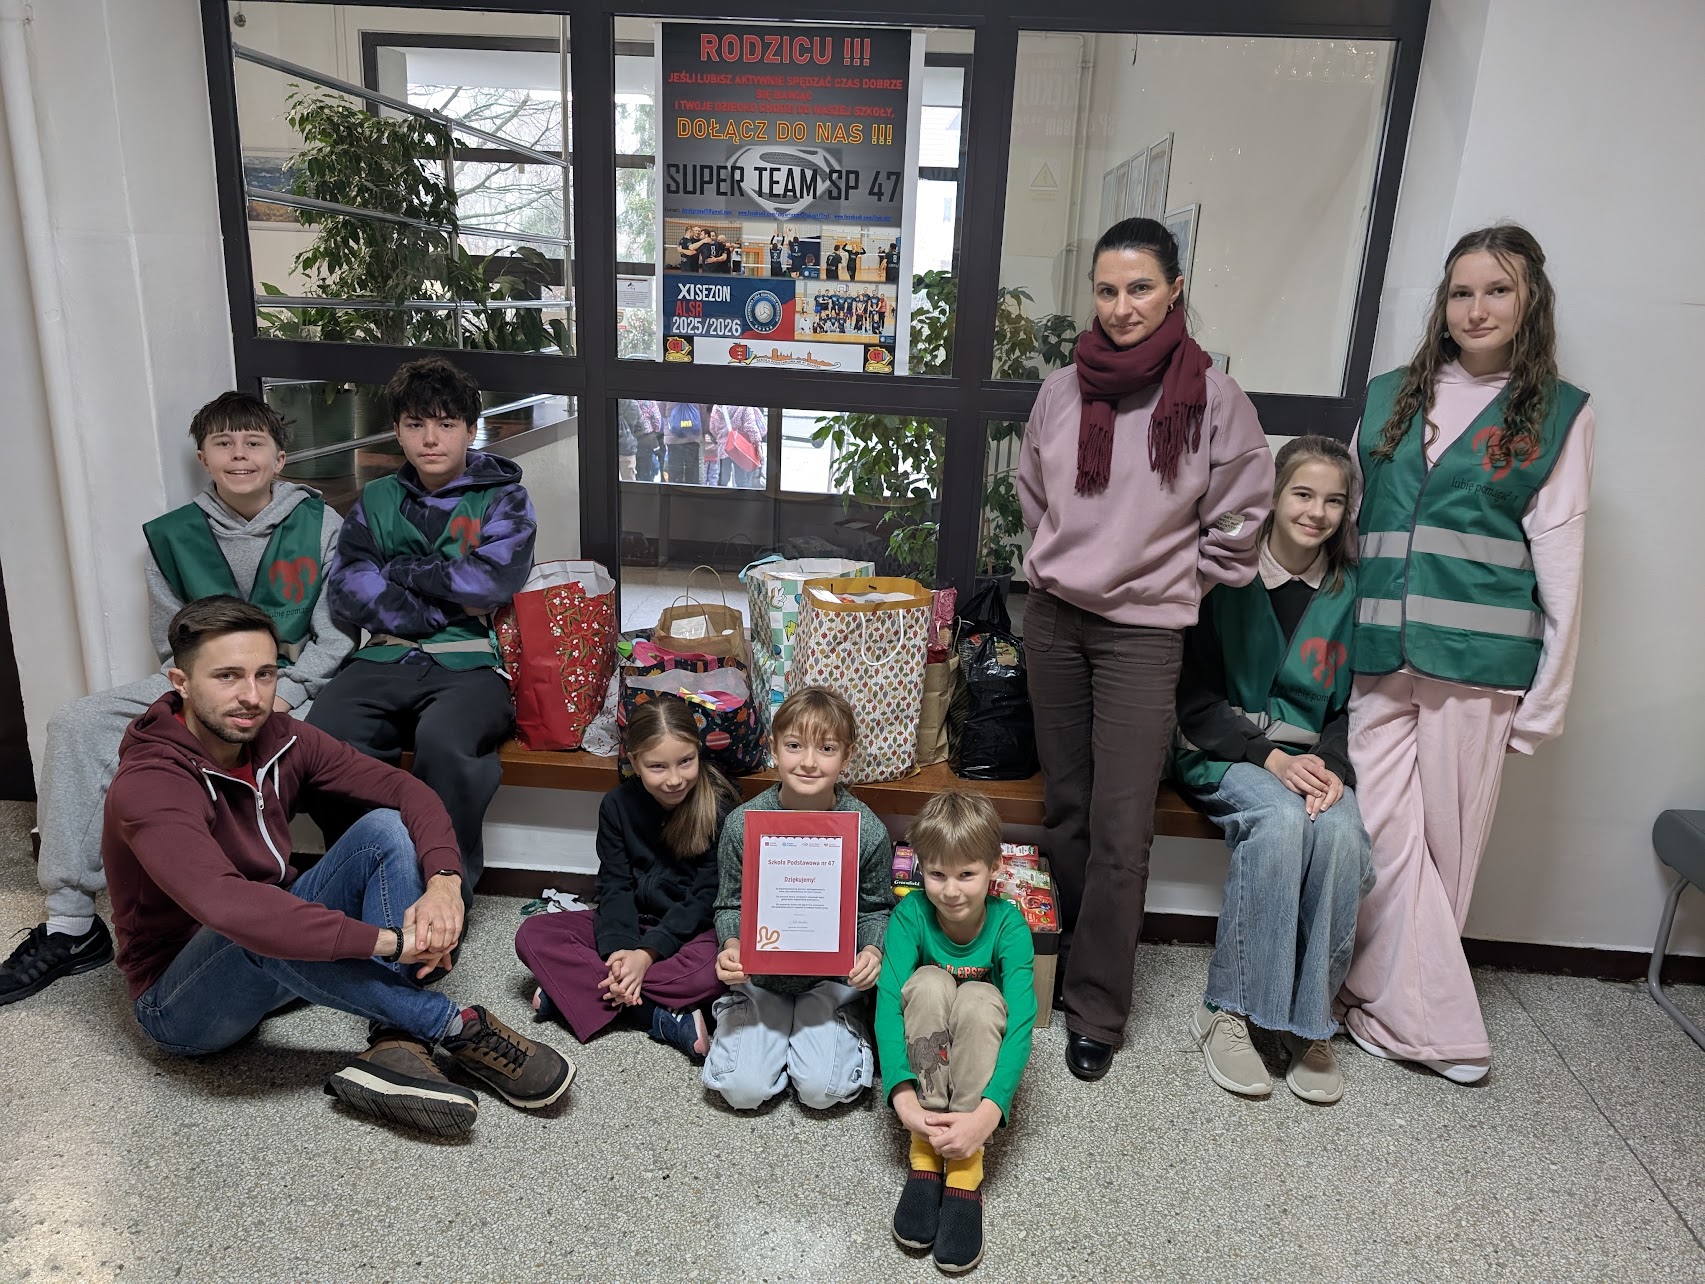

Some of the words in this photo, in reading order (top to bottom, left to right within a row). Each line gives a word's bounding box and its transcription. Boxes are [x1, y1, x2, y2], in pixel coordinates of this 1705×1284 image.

[700, 33, 832, 65] RODZICU
[843, 38, 871, 66] !!!
[668, 71, 696, 83] JEŚLI
[697, 73, 732, 84] LUBISZ
[735, 74, 784, 86] AKTYWNIE
[786, 75, 831, 88] SPĘDZAĆ
[834, 78, 860, 88] CZAS
[862, 78, 903, 89] DOBRZE
[680, 101, 712, 111] TWOJE
[677, 117, 768, 144] DOŁĄCZ
[776, 120, 807, 142] DO
[815, 122, 863, 144] NAS
[871, 124, 893, 145] !!!
[666, 163, 745, 197] SUPER
[754, 166, 817, 199] TEAM
[827, 169, 860, 201] SP
[868, 170, 901, 202] 47
[677, 283, 694, 299] XI
[696, 284, 731, 302] SEZON
[672, 316, 741, 336] 2025/2026
[784, 876, 816, 884] Dziękujemy!
